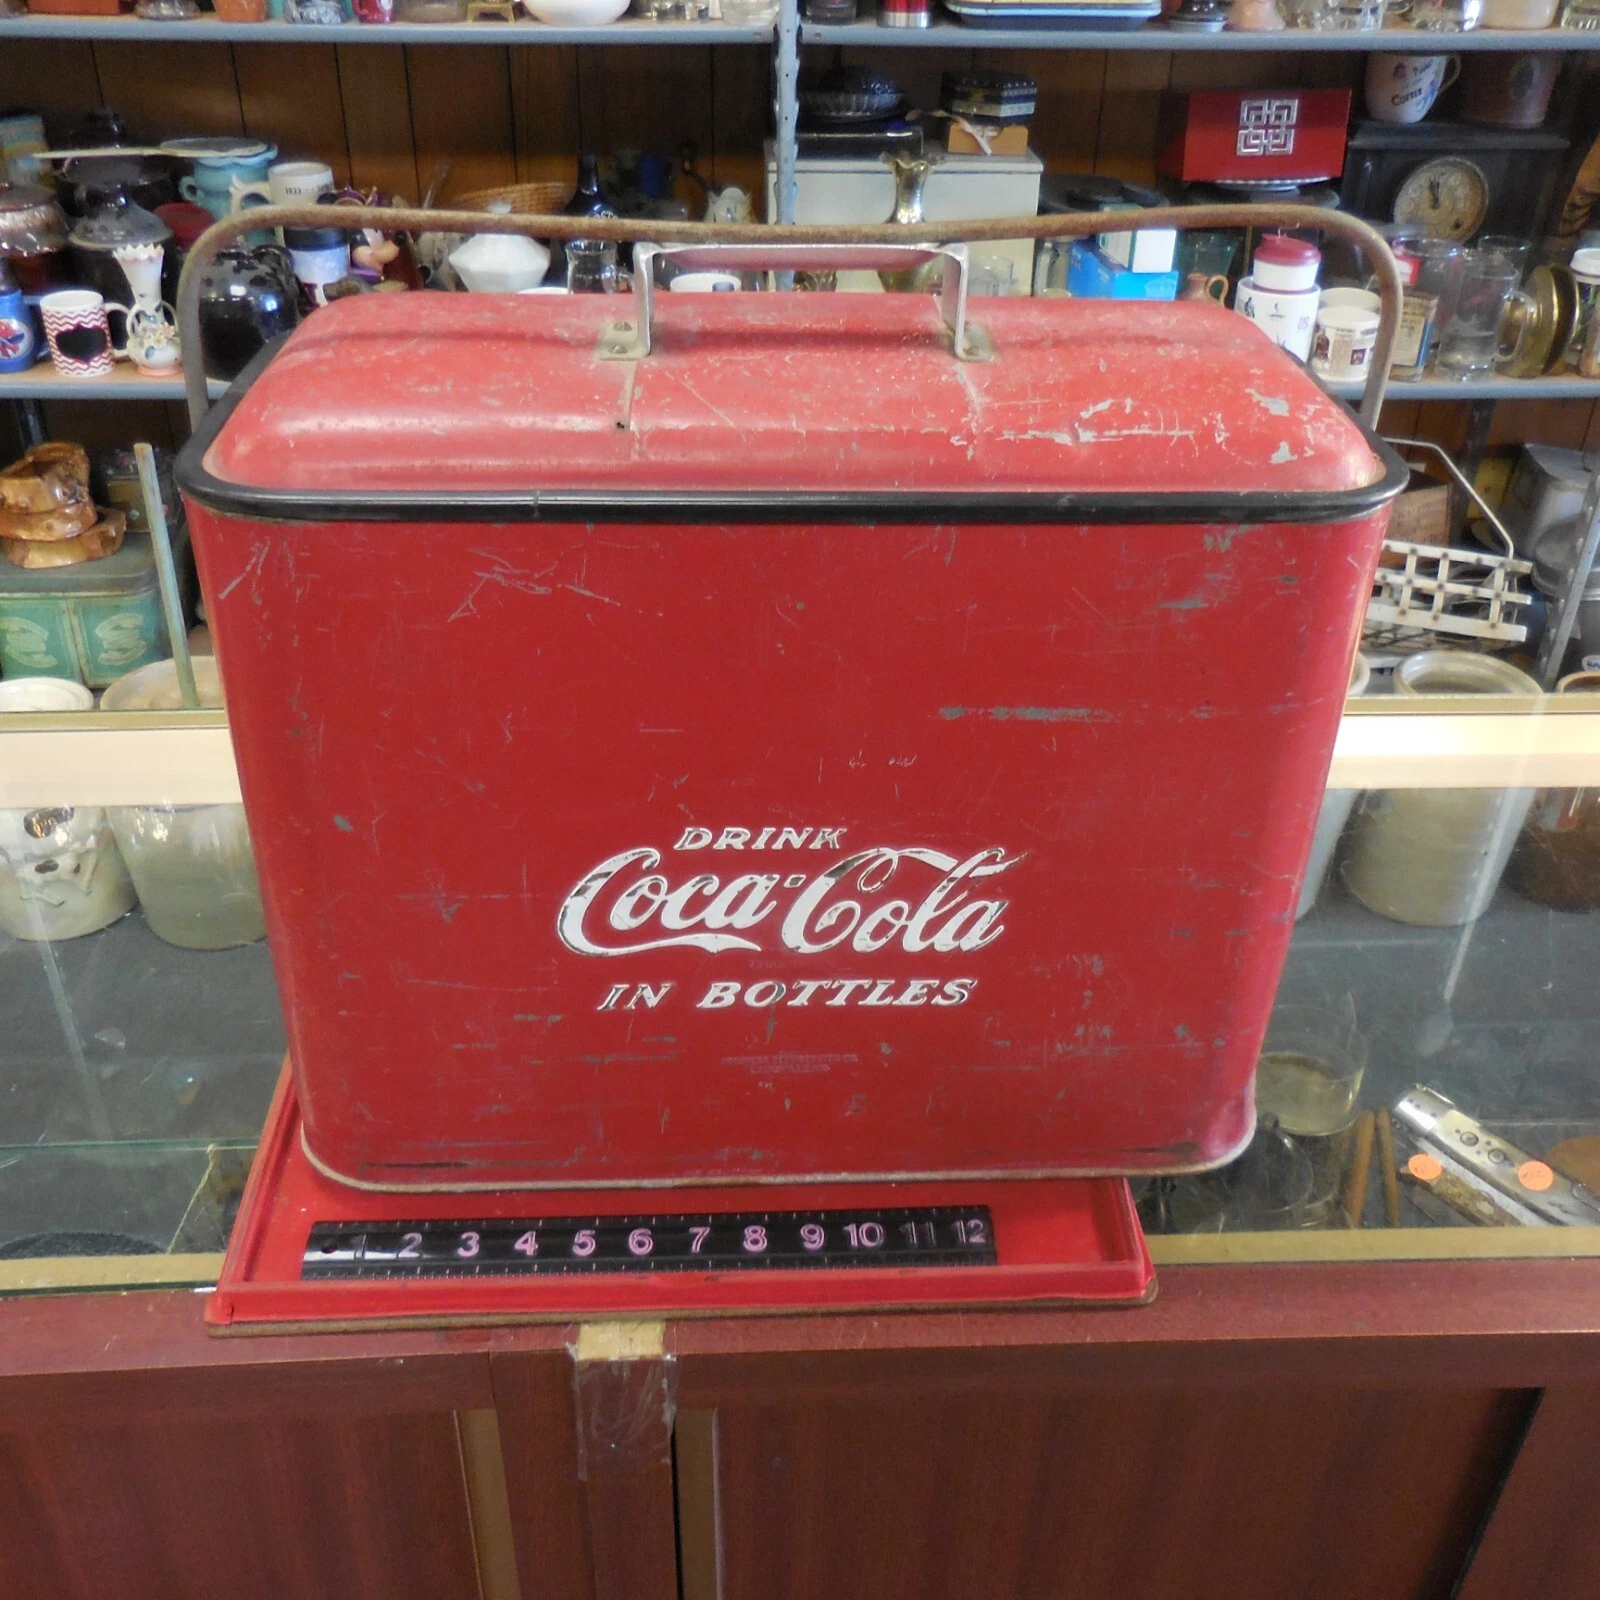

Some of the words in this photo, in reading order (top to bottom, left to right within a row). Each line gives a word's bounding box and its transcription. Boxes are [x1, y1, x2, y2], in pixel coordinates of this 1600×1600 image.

[673, 827, 848, 851] DRINK
[557, 847, 1028, 957] Coca-Cola
[597, 983, 672, 1010] IN
[696, 979, 976, 1009] BOTTLES
[398, 1232, 423, 1259] 2
[457, 1231, 480, 1257] 3
[514, 1230, 539, 1257] 4
[572, 1229, 596, 1257] 5
[628, 1228, 653, 1256] 6
[688, 1226, 710, 1253] 7
[743, 1225, 767, 1252] 8
[800, 1223, 825, 1250] 9
[843, 1221, 884, 1248] 10
[900, 1220, 937, 1246] 11
[953, 1218, 987, 1245] 12
